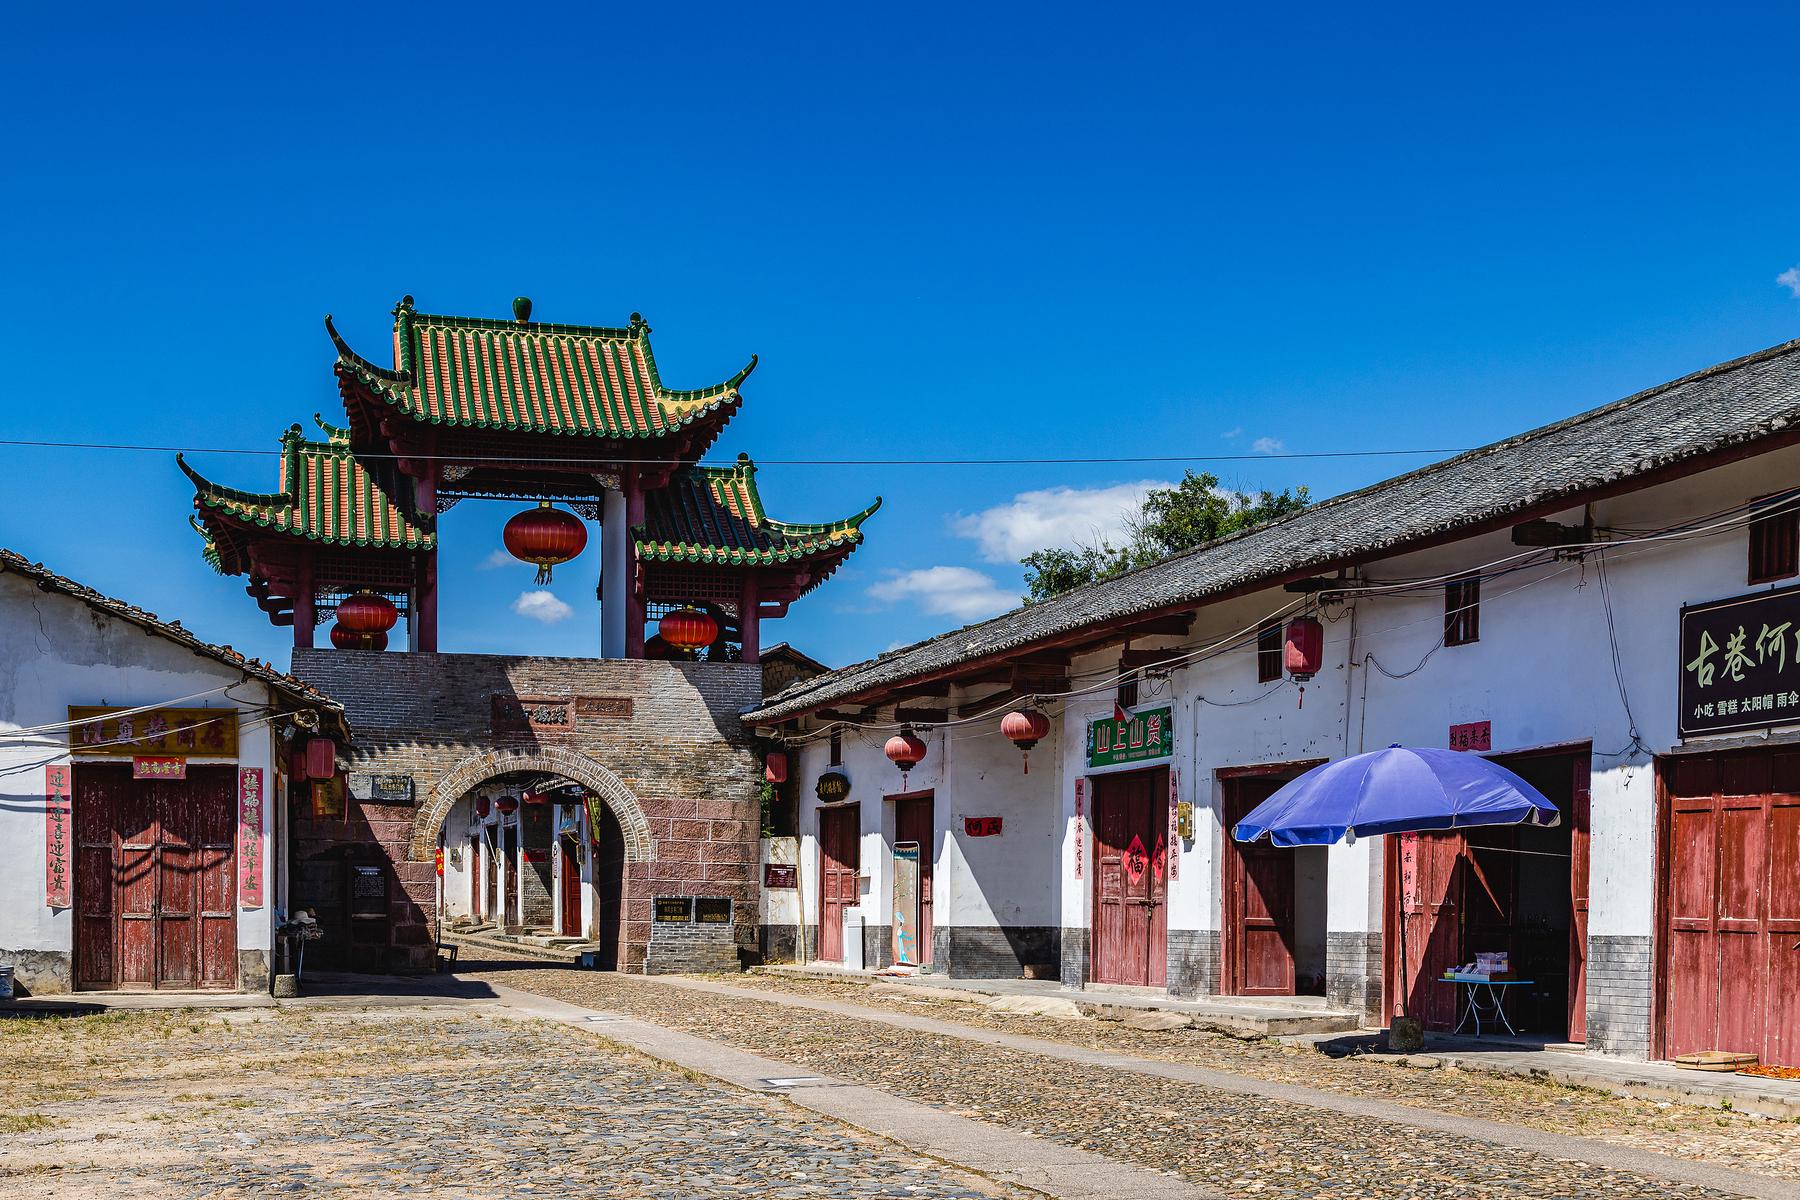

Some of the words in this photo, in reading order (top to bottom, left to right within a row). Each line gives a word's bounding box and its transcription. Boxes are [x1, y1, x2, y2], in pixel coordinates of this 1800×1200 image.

[1686, 621, 1800, 689] 古巷何
[1693, 702, 1715, 719] 小吃
[1717, 699, 1738, 716] 雪糕
[1741, 694, 1774, 713] 太阳帽
[1776, 690, 1799, 708] 雨伞
[1097, 714, 1161, 753] 山上山货
[1128, 845, 1145, 875] 福
